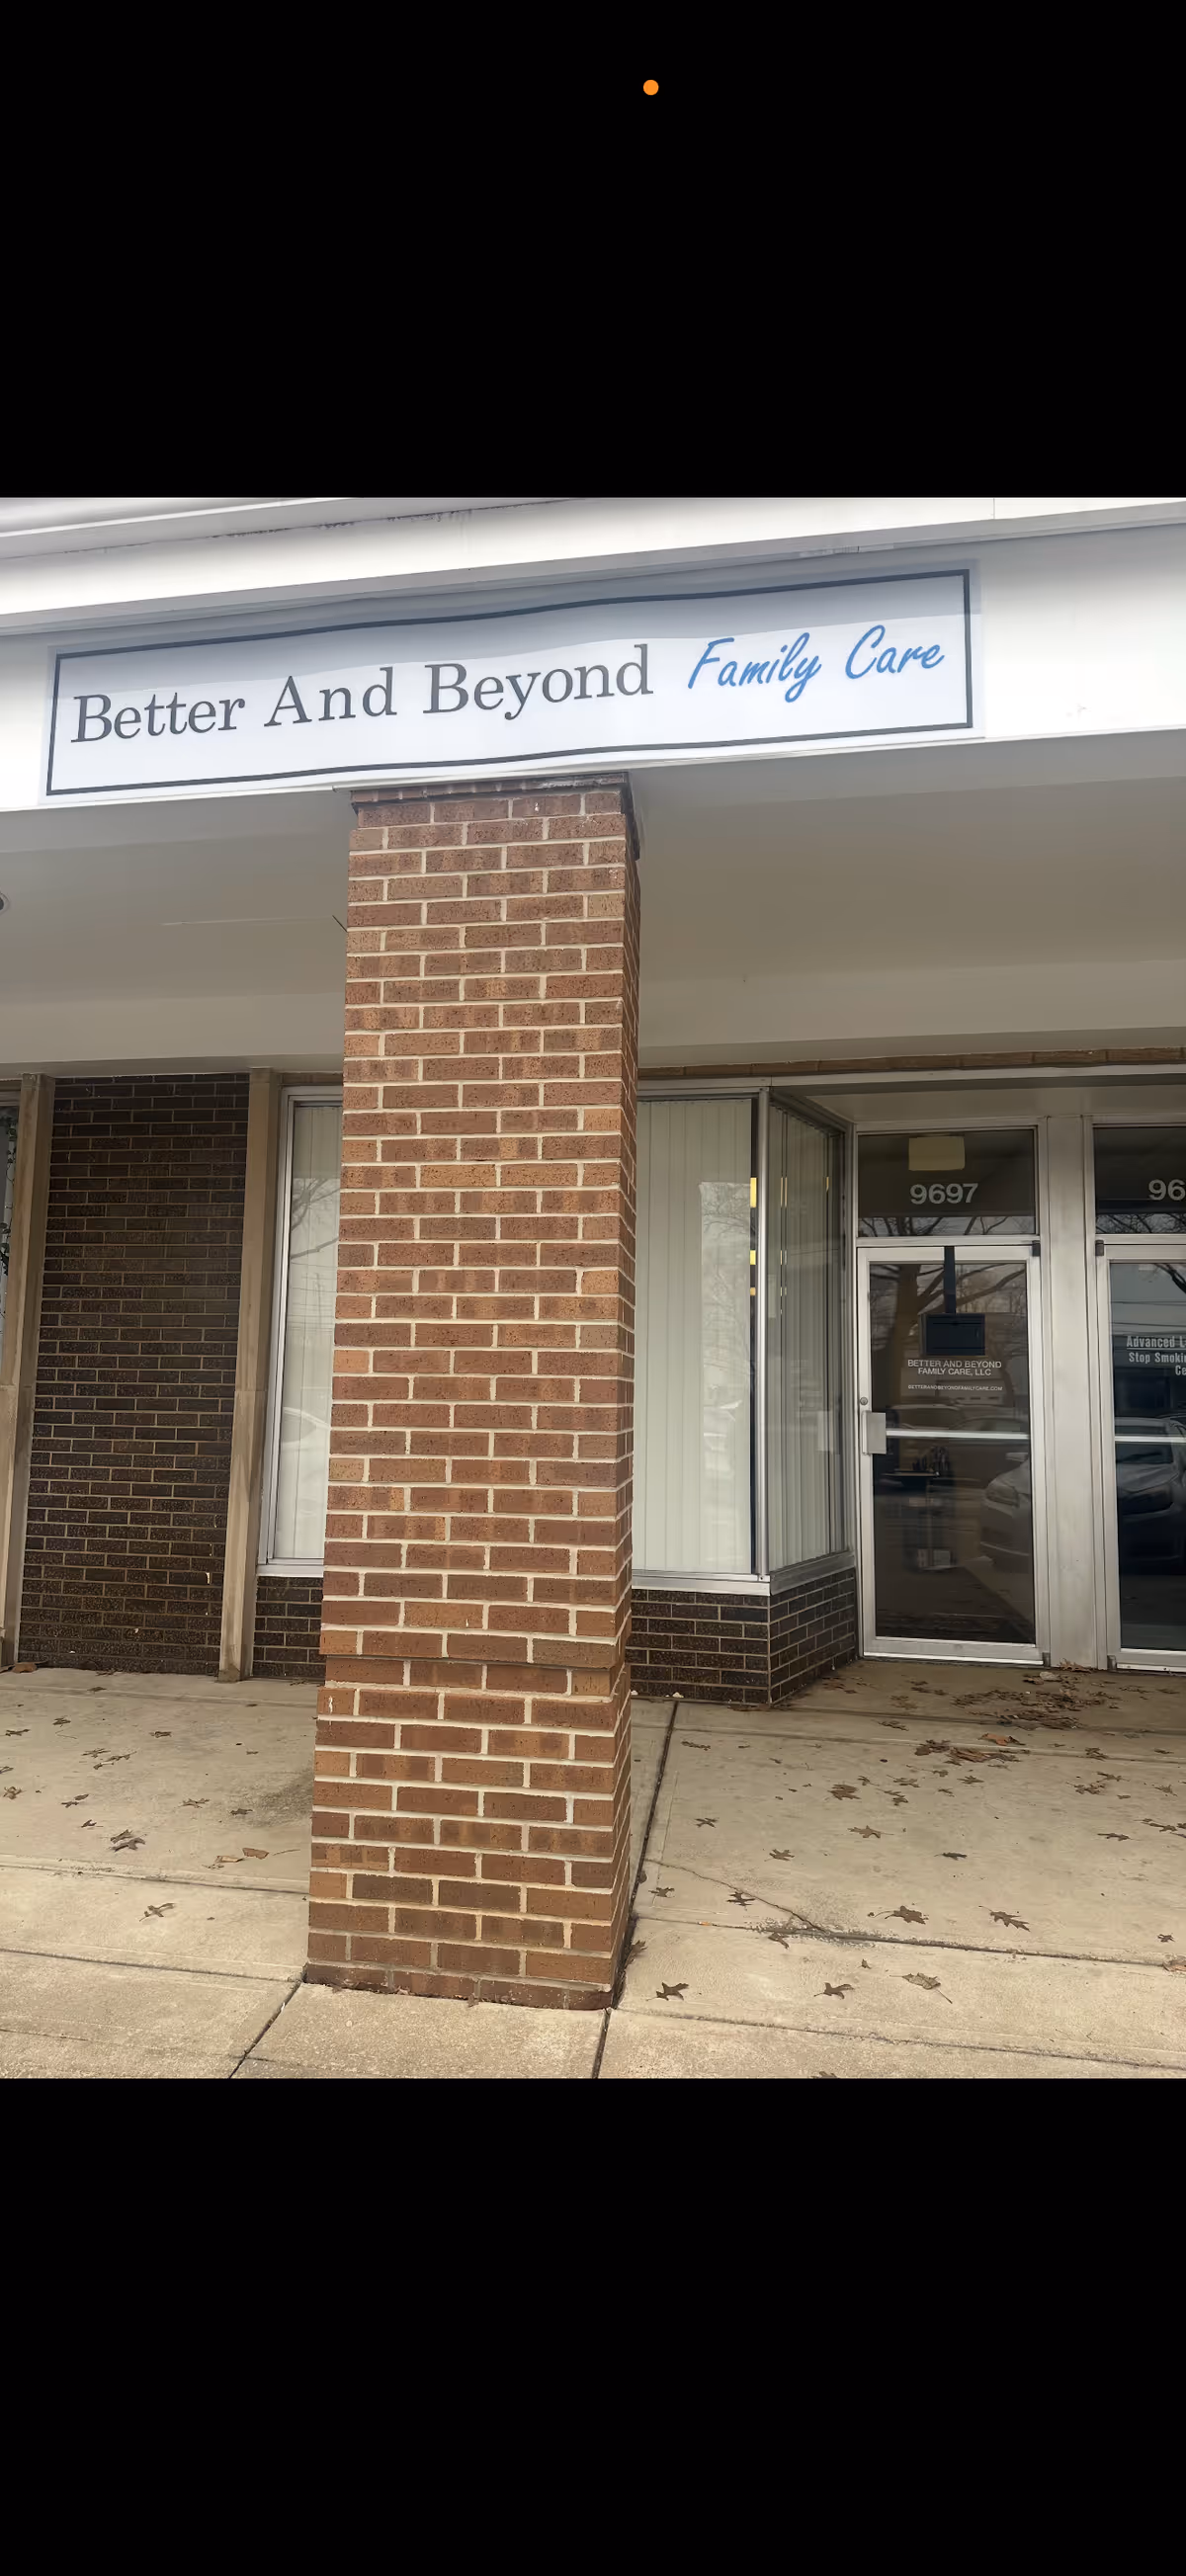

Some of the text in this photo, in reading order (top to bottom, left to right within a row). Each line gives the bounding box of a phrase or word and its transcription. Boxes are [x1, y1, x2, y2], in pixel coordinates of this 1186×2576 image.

[71, 624, 946, 743] Better And Beyond Family Care
[909, 1183, 978, 1205] 9697
[1148, 1179, 1186, 1202] 96
[1126, 1335, 1186, 1348] Advanced L
[907, 1359, 942, 1368] BETTER
[964, 1360, 1002, 1369] BEYOND
[1129, 1352, 1150, 1364] Stop
[948, 1368, 974, 1376] CARE,
